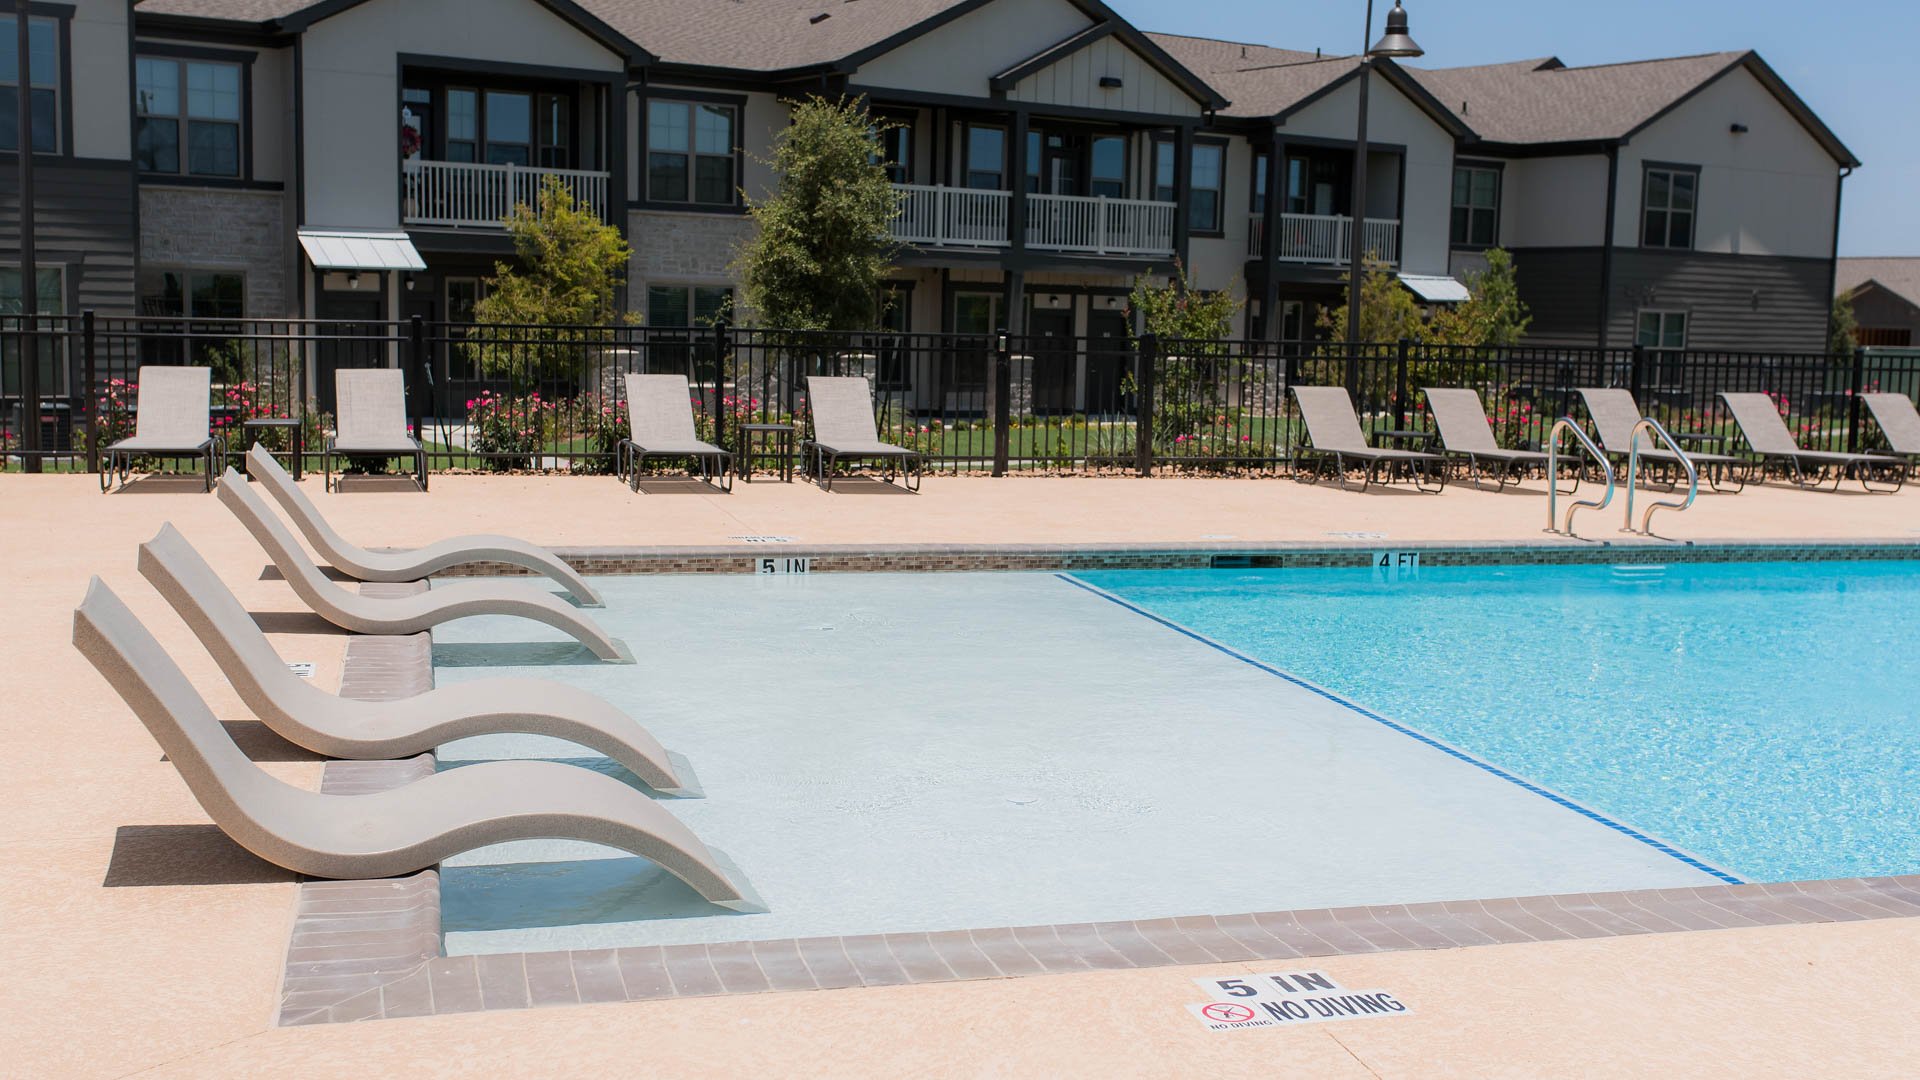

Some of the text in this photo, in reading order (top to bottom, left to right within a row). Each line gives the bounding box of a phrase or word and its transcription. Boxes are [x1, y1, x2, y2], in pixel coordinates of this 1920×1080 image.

[763, 558, 805, 573] 5 IN
[1379, 553, 1417, 567] 4 FT
[1216, 972, 1336, 997] 5 IN
[1260, 993, 1406, 1021] NO DIVING
[1231, 1019, 1273, 1029] DIVING
